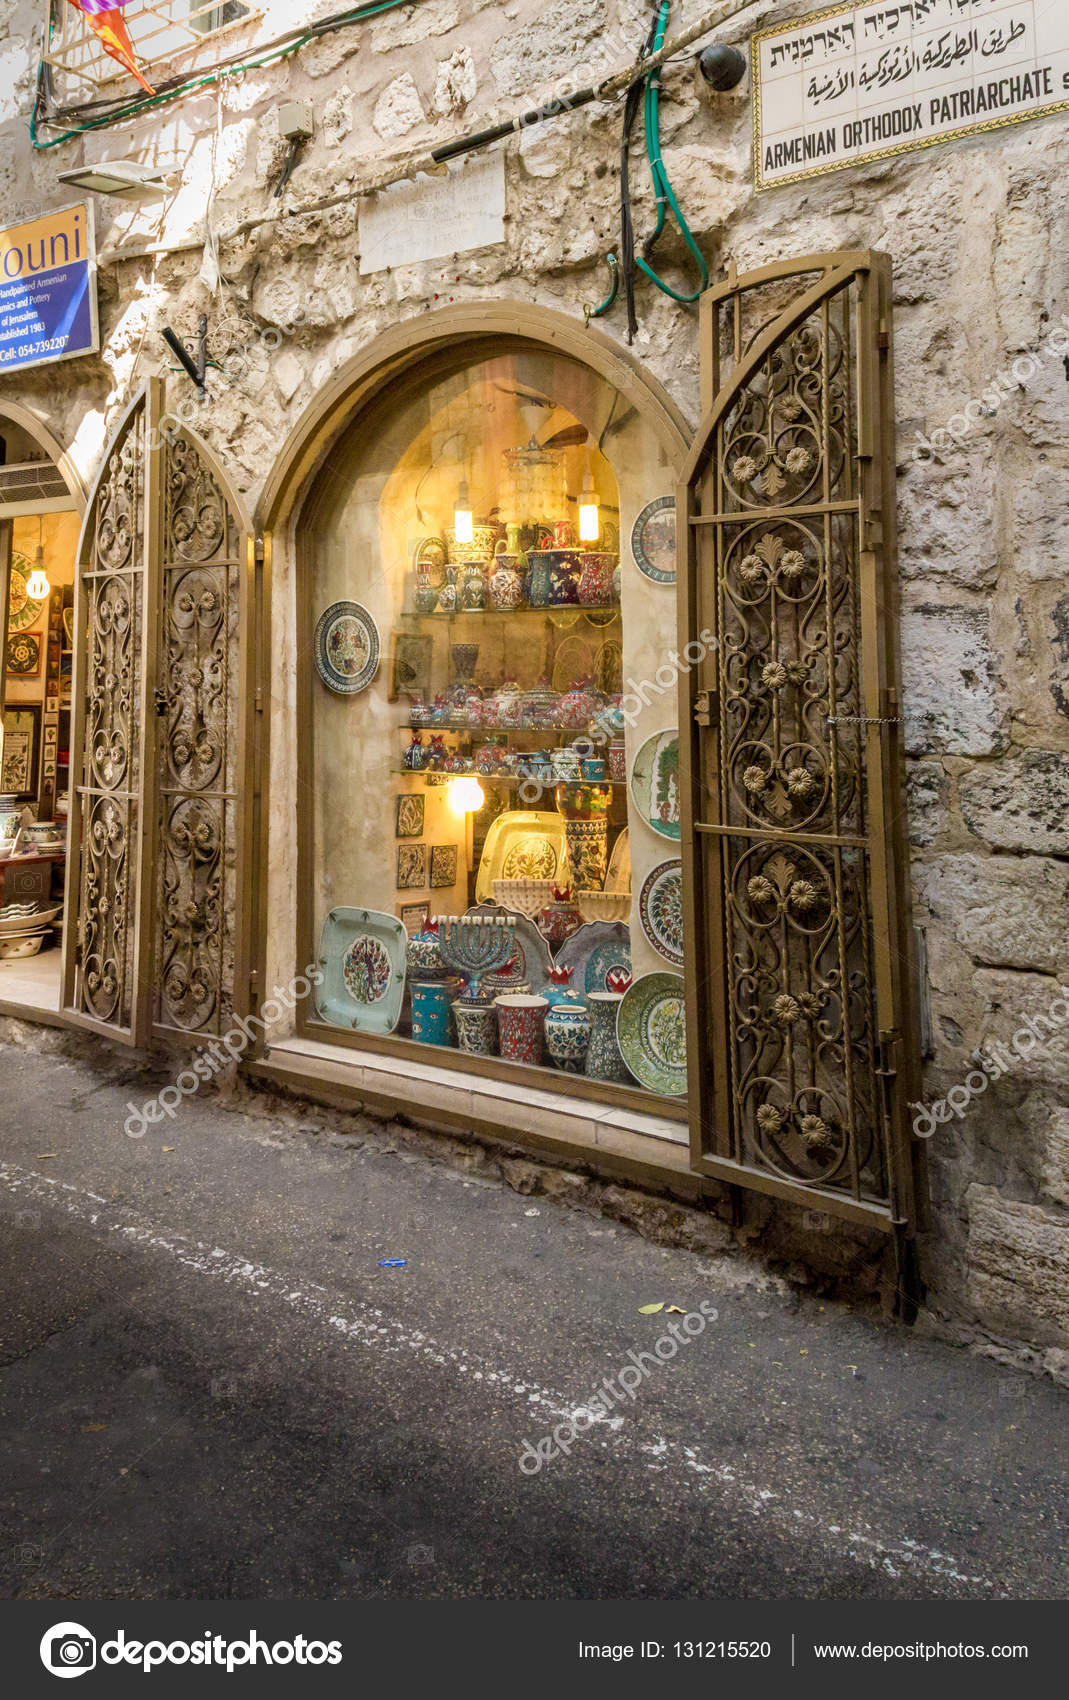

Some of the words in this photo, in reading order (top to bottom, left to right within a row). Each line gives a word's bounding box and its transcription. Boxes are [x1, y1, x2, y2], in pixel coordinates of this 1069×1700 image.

[981, 20, 1026, 56] طريق
[764, 127, 836, 171] ARMENIAN
[843, 103, 923, 149] ORTHODOX
[930, 66, 1053, 125] PATRIARCHATE
[0, 215, 80, 278] ouni
[37, 273, 67, 288] Armenian
[16, 296, 28, 309] and
[29, 293, 51, 305] Pottery
[1, 316, 8, 326] of
[9, 310, 38, 326] Jerusalem
[30, 322, 46, 334] 1983
[0, 347, 17, 361] Cell:
[18, 334, 70, 357] 054-7392207
